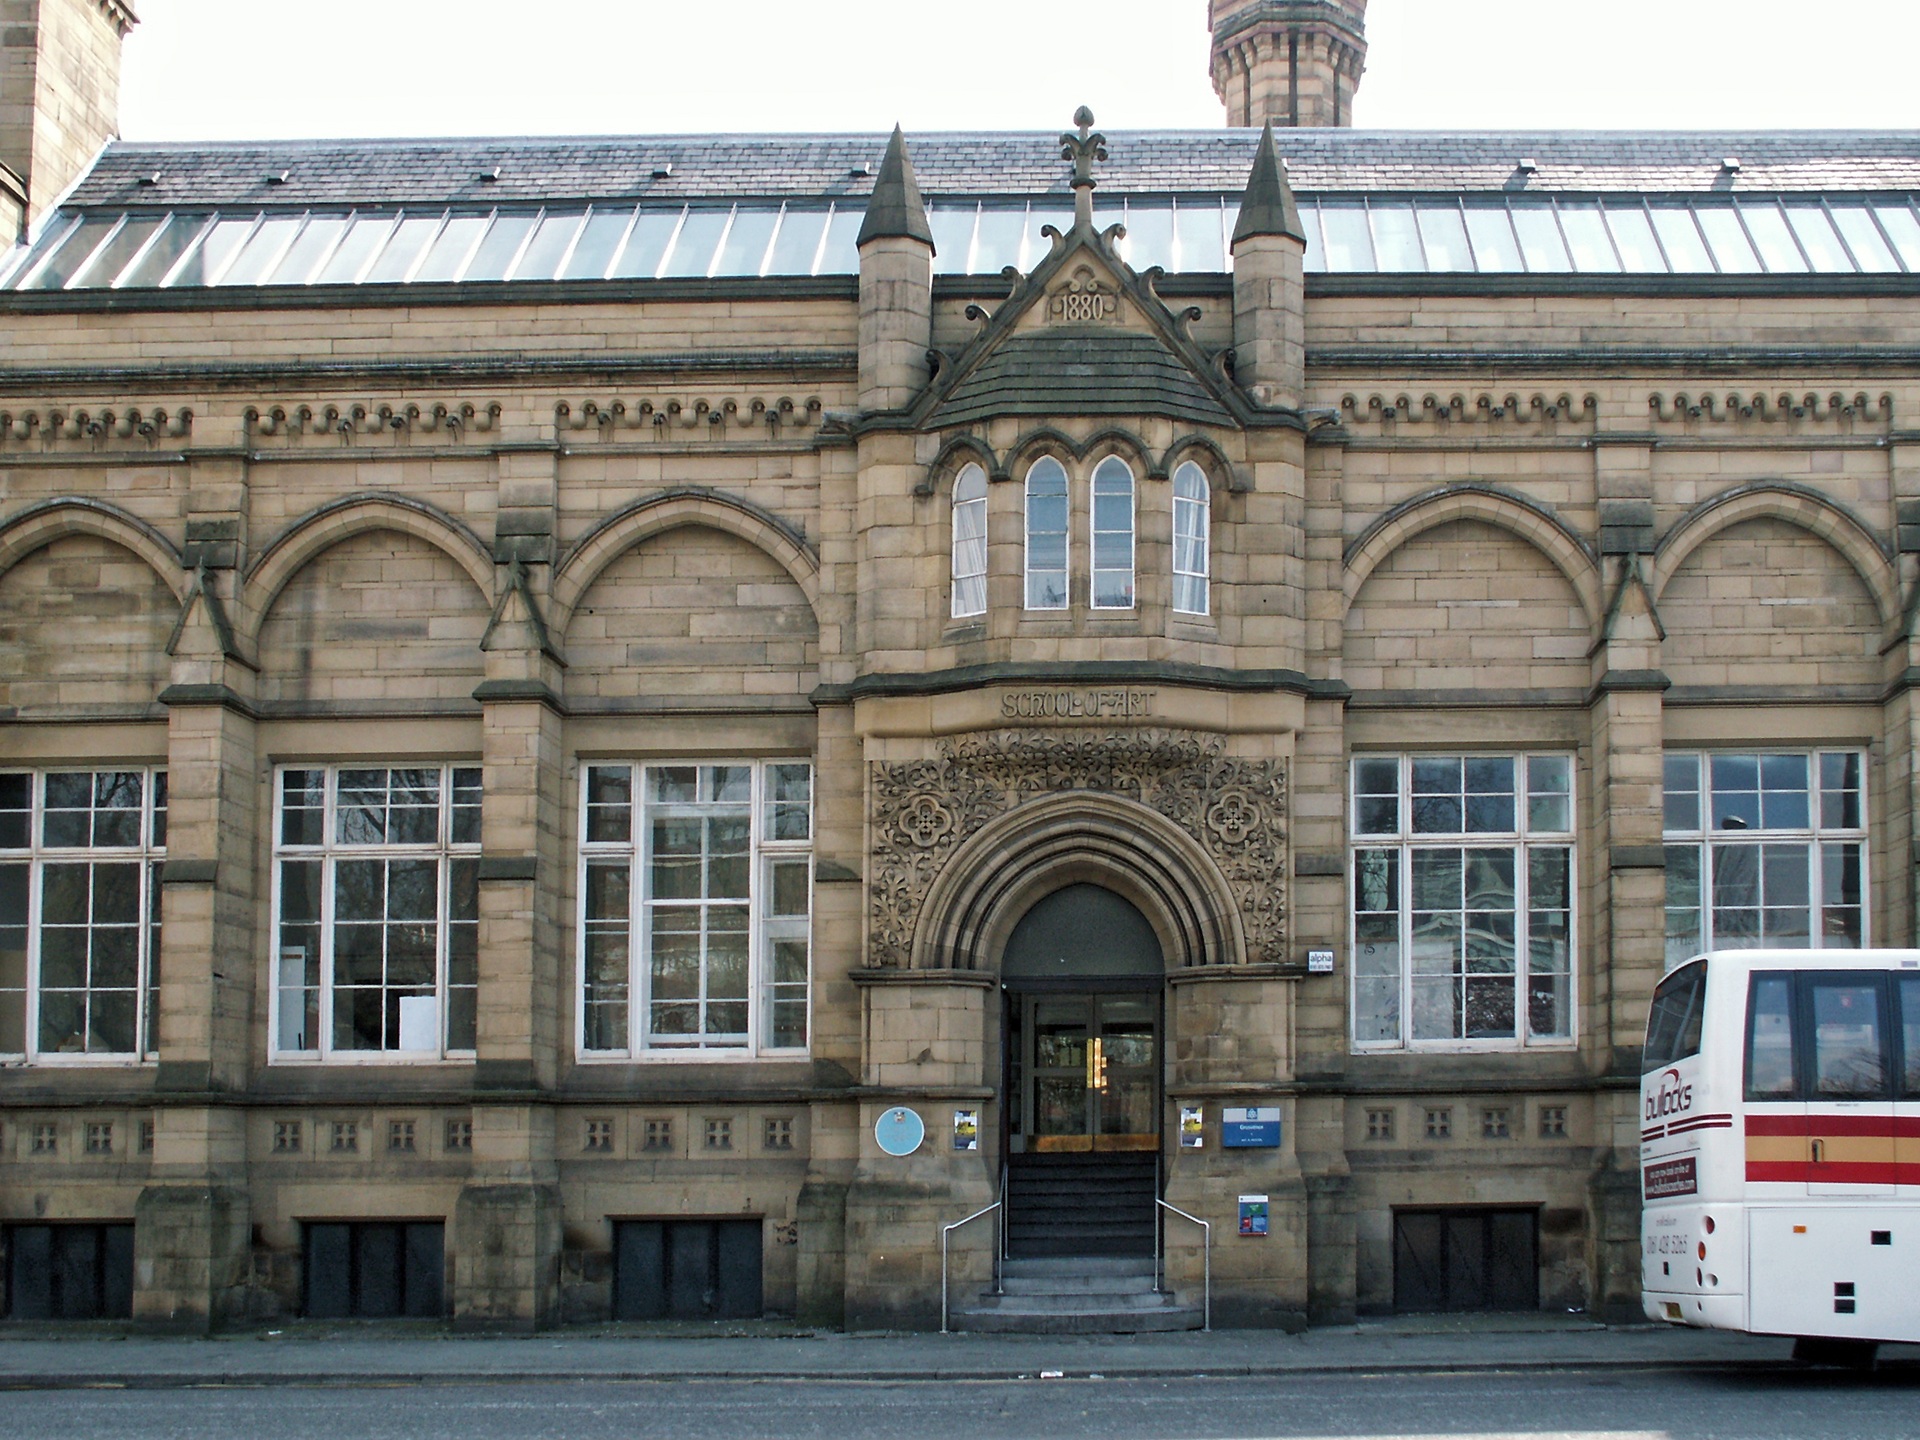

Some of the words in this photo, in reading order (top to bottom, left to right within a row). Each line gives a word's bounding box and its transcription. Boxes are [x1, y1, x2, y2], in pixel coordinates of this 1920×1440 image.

[1062, 294, 1103, 321] 1880
[1001, 692, 1082, 718] SCHOOL
[1084, 690, 1109, 717] OF
[1109, 690, 1157, 717] ART
[1310, 953, 1332, 964] alpha
[1645, 1078, 1692, 1121] bullocks
